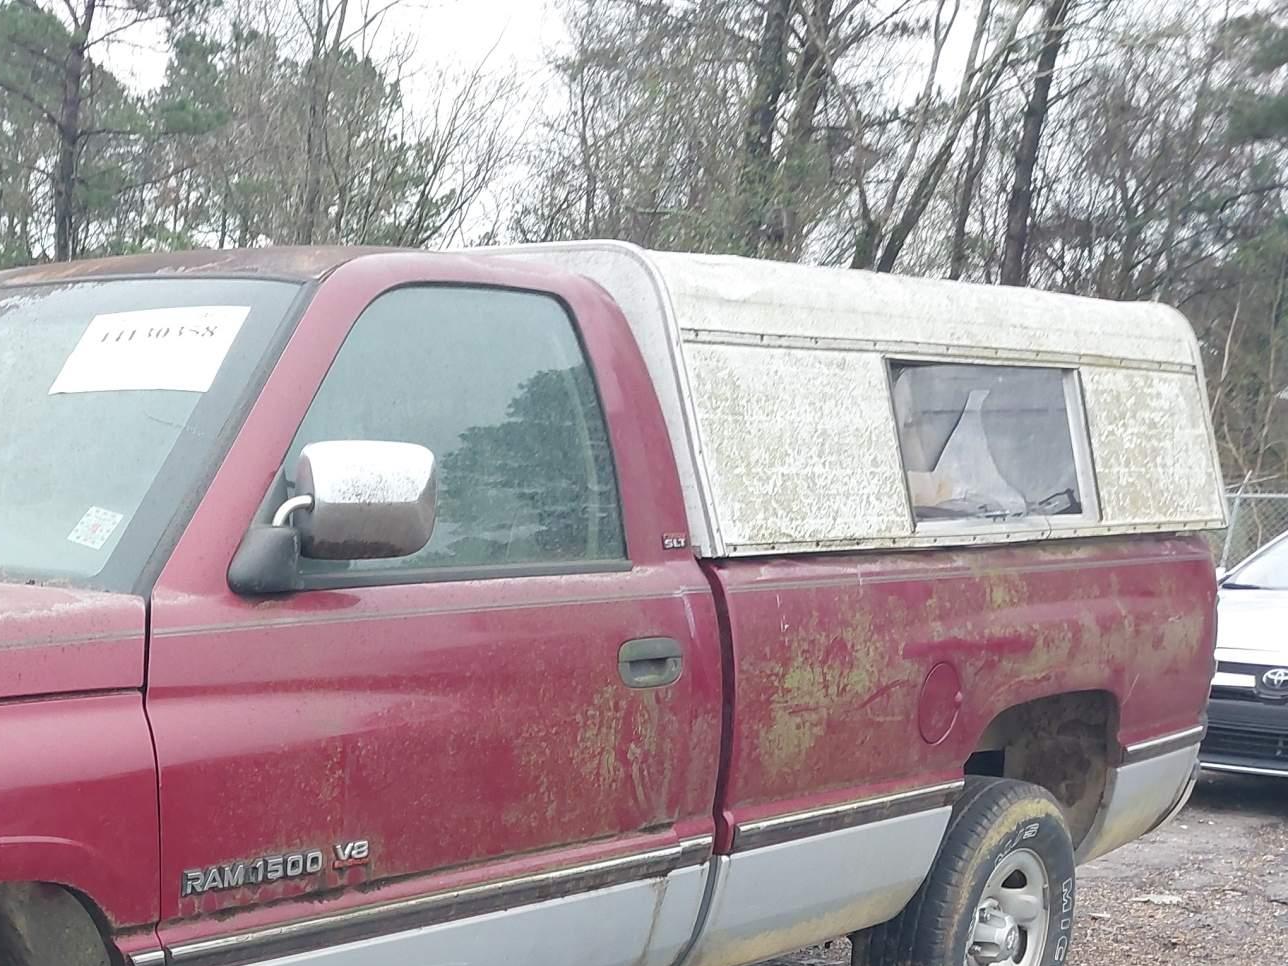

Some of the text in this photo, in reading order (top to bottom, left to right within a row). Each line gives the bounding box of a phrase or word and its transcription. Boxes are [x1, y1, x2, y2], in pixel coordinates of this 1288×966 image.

[664, 538, 686, 549] SLT
[183, 840, 369, 896] RAM 1500 V8
